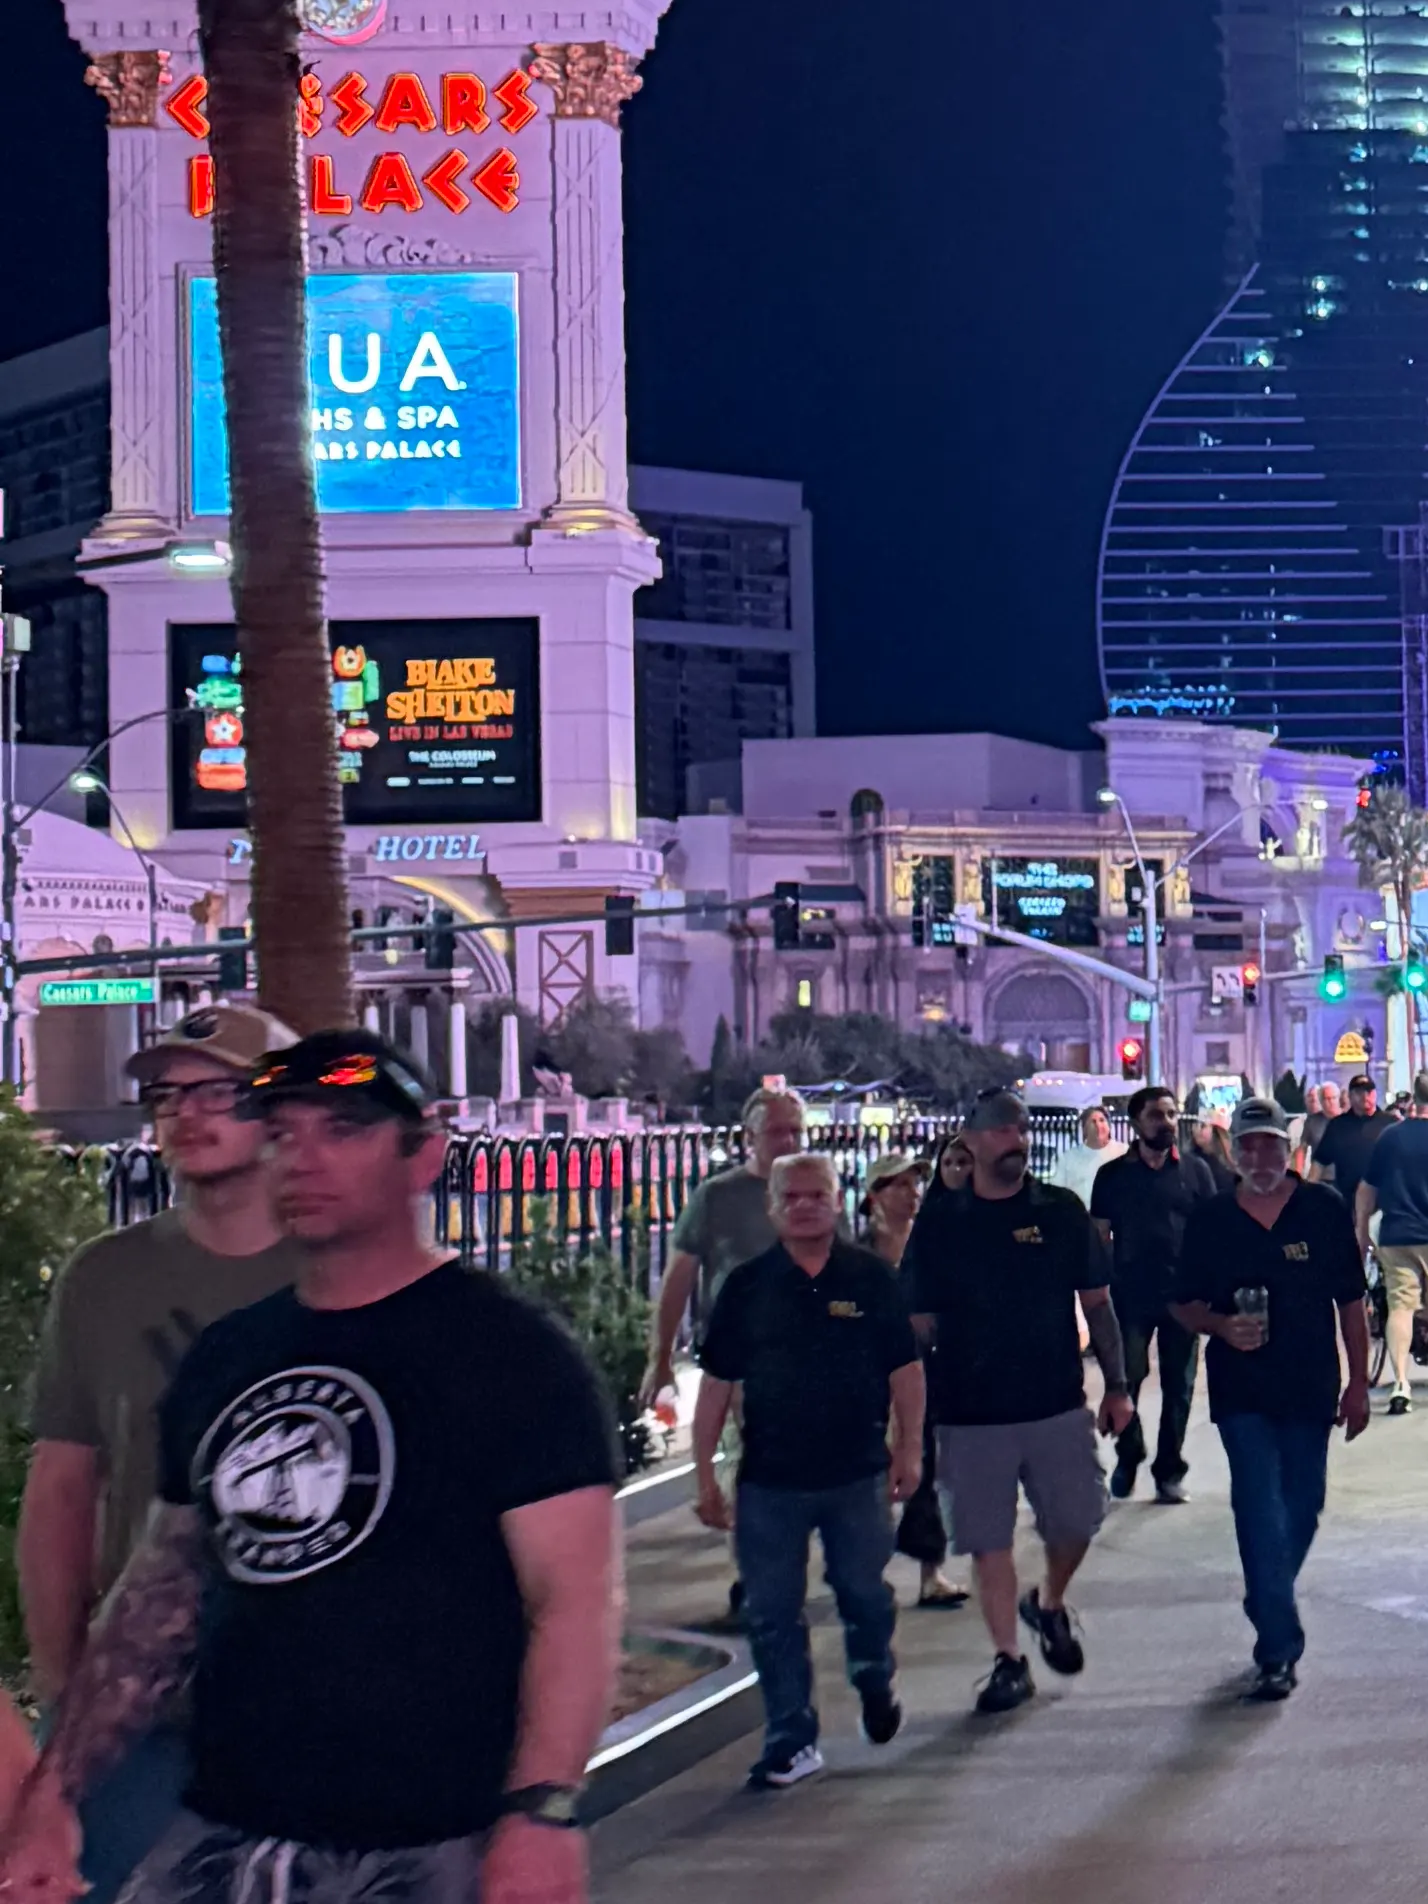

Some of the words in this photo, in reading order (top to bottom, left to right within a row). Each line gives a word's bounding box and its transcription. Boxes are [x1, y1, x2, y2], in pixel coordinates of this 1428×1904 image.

[364, 406, 387, 430] &
[397, 405, 459, 430] SPA
[366, 439, 461, 460] PALACE
[406, 658, 496, 690] BLAKE
[386, 689, 515, 724] SHELTON
[375, 834, 486, 862] HOTEL
